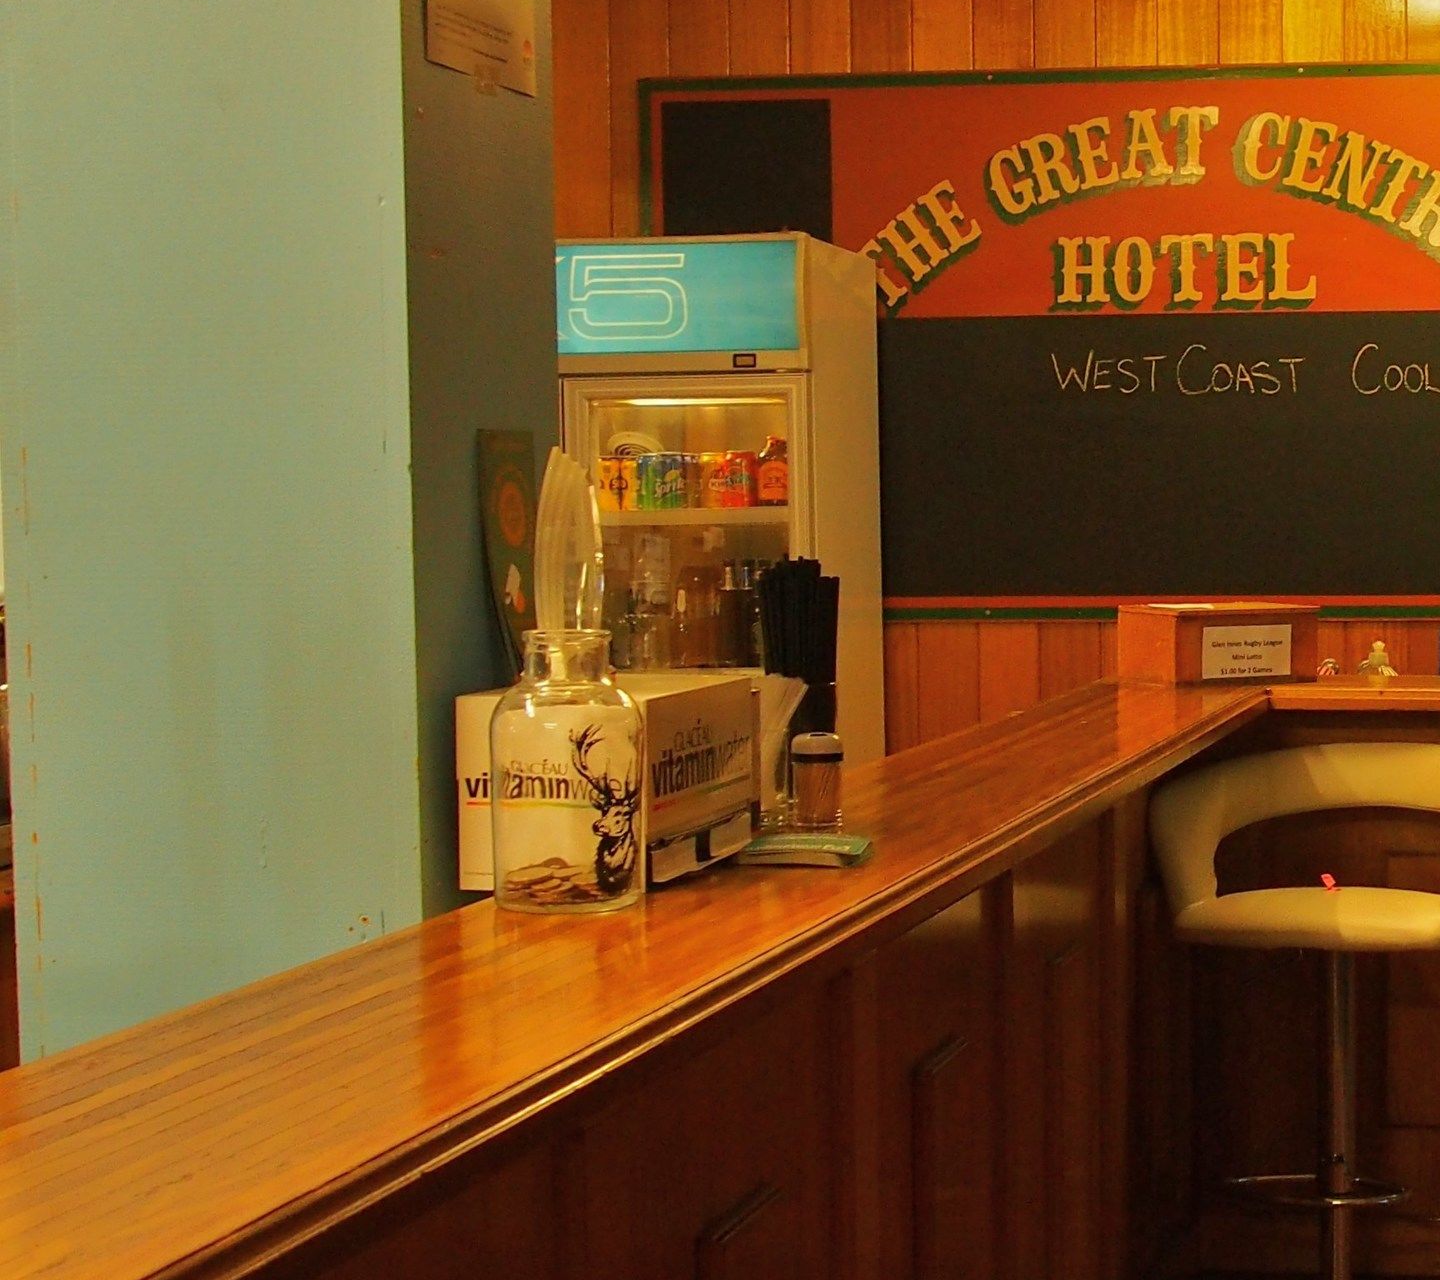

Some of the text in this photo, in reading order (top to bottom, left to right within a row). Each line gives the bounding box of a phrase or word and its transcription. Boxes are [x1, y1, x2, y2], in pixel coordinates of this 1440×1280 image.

[858, 180, 983, 308] THE
[987, 105, 1219, 217] GREAT
[1055, 232, 1317, 306] HOTEL
[1051, 349, 1168, 394] WEST
[1176, 343, 1306, 395] COAST
